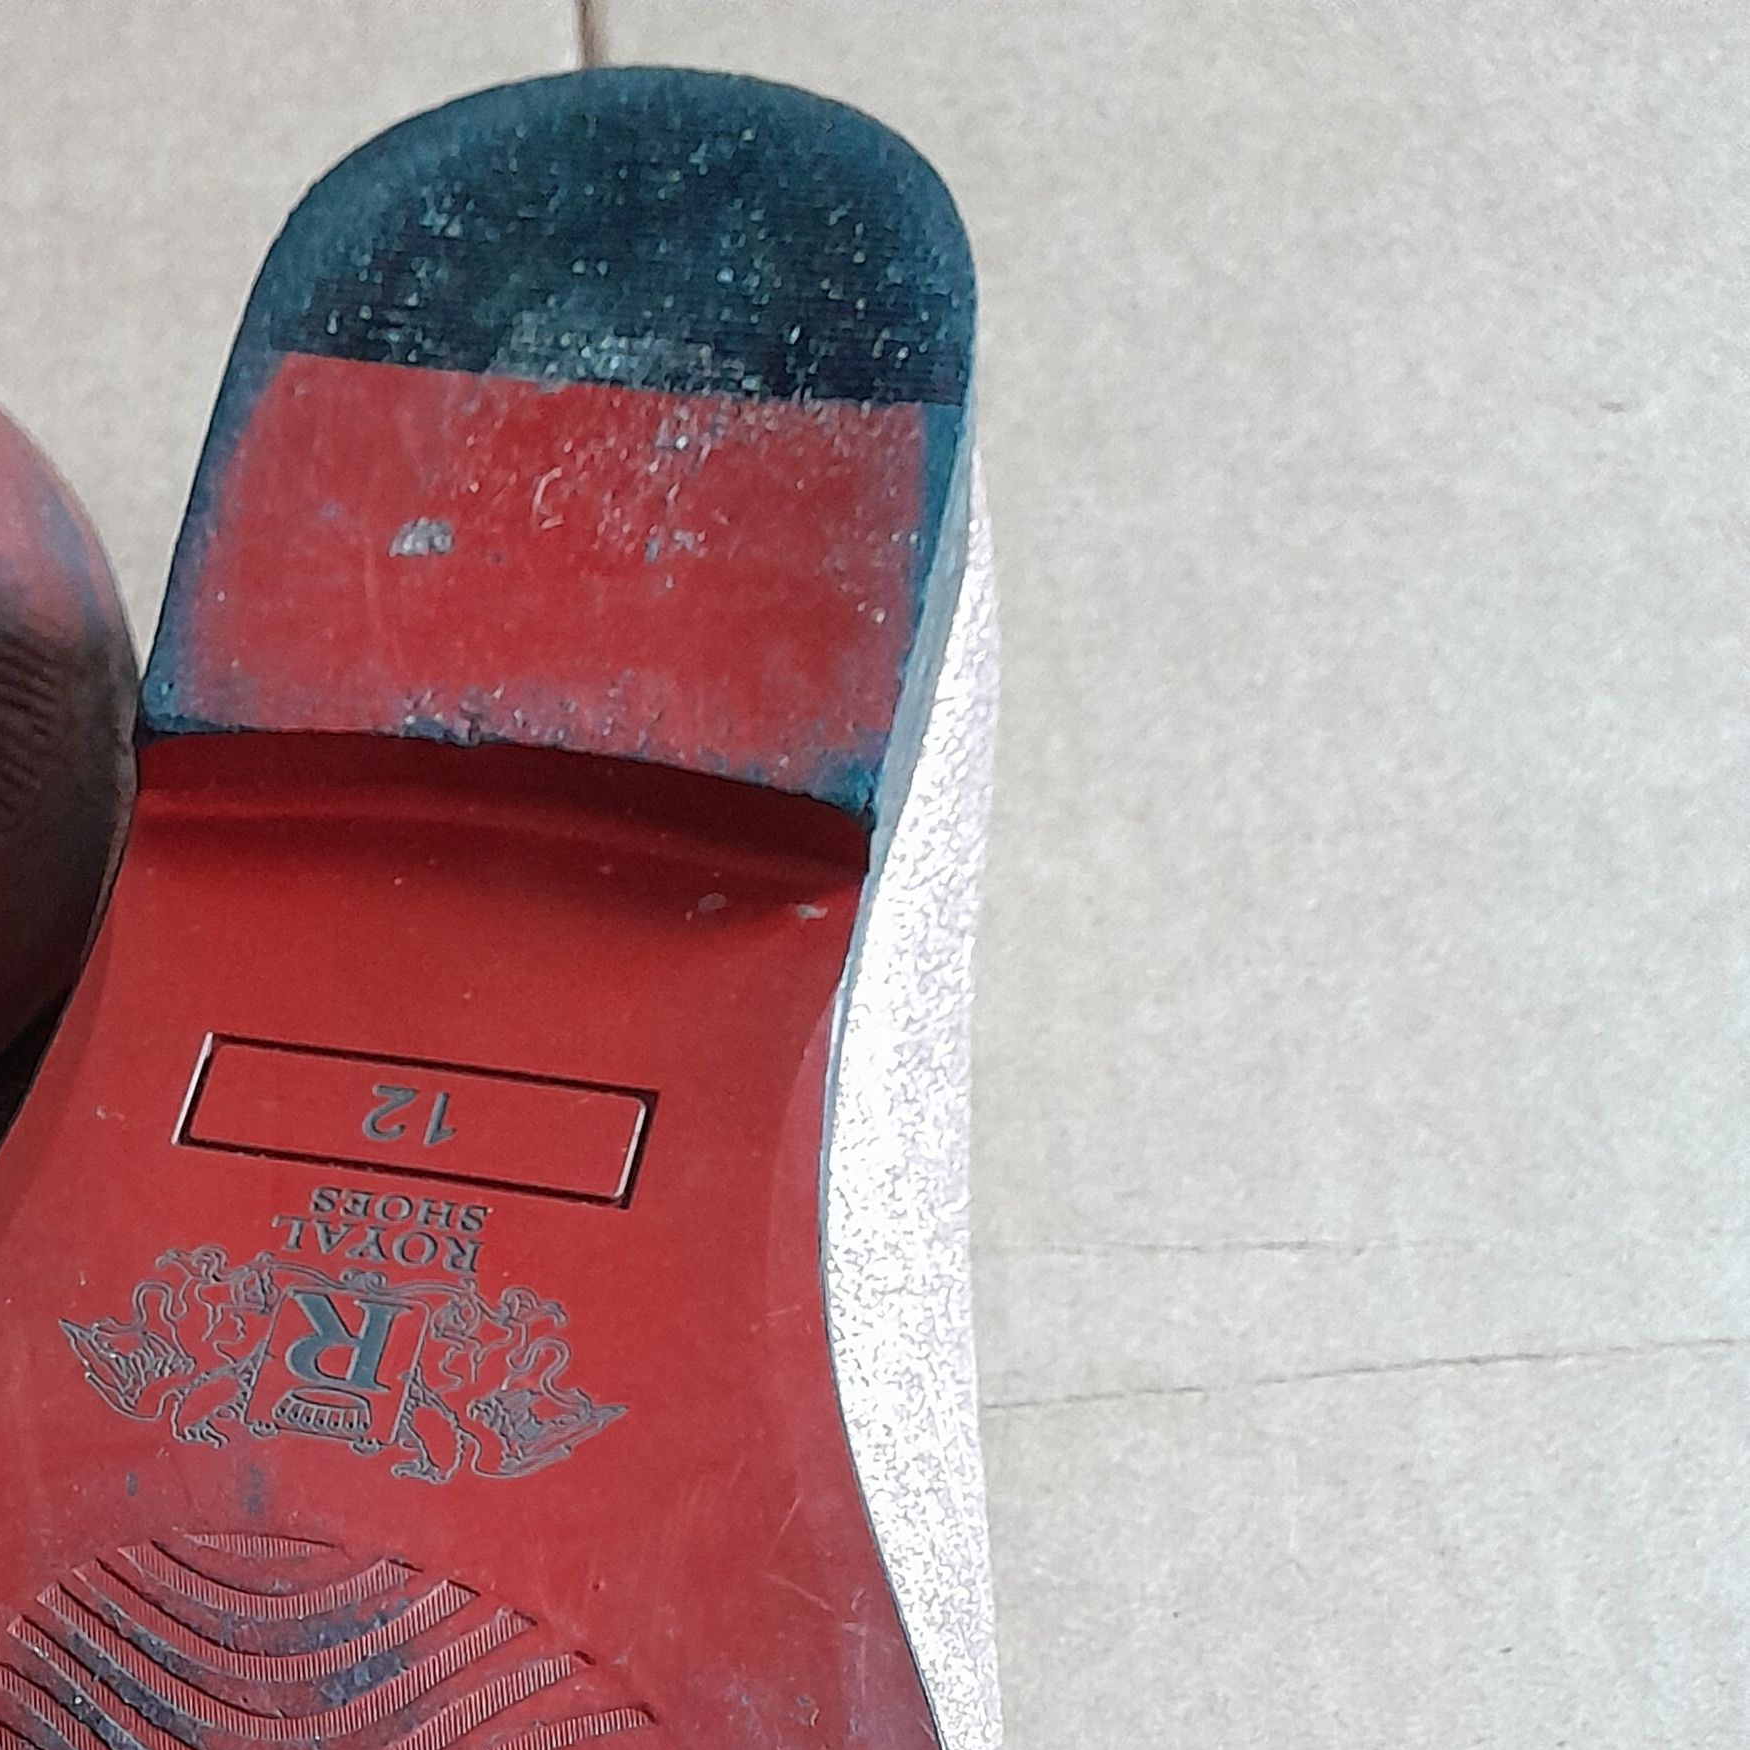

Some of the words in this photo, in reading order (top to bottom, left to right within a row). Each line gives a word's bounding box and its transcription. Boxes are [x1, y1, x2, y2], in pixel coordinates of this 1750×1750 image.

[362, 1083, 456, 1148] 12
[309, 1186, 489, 1233] SHOES
[271, 1214, 484, 1274] ROYAL
[285, 1291, 414, 1393] R
